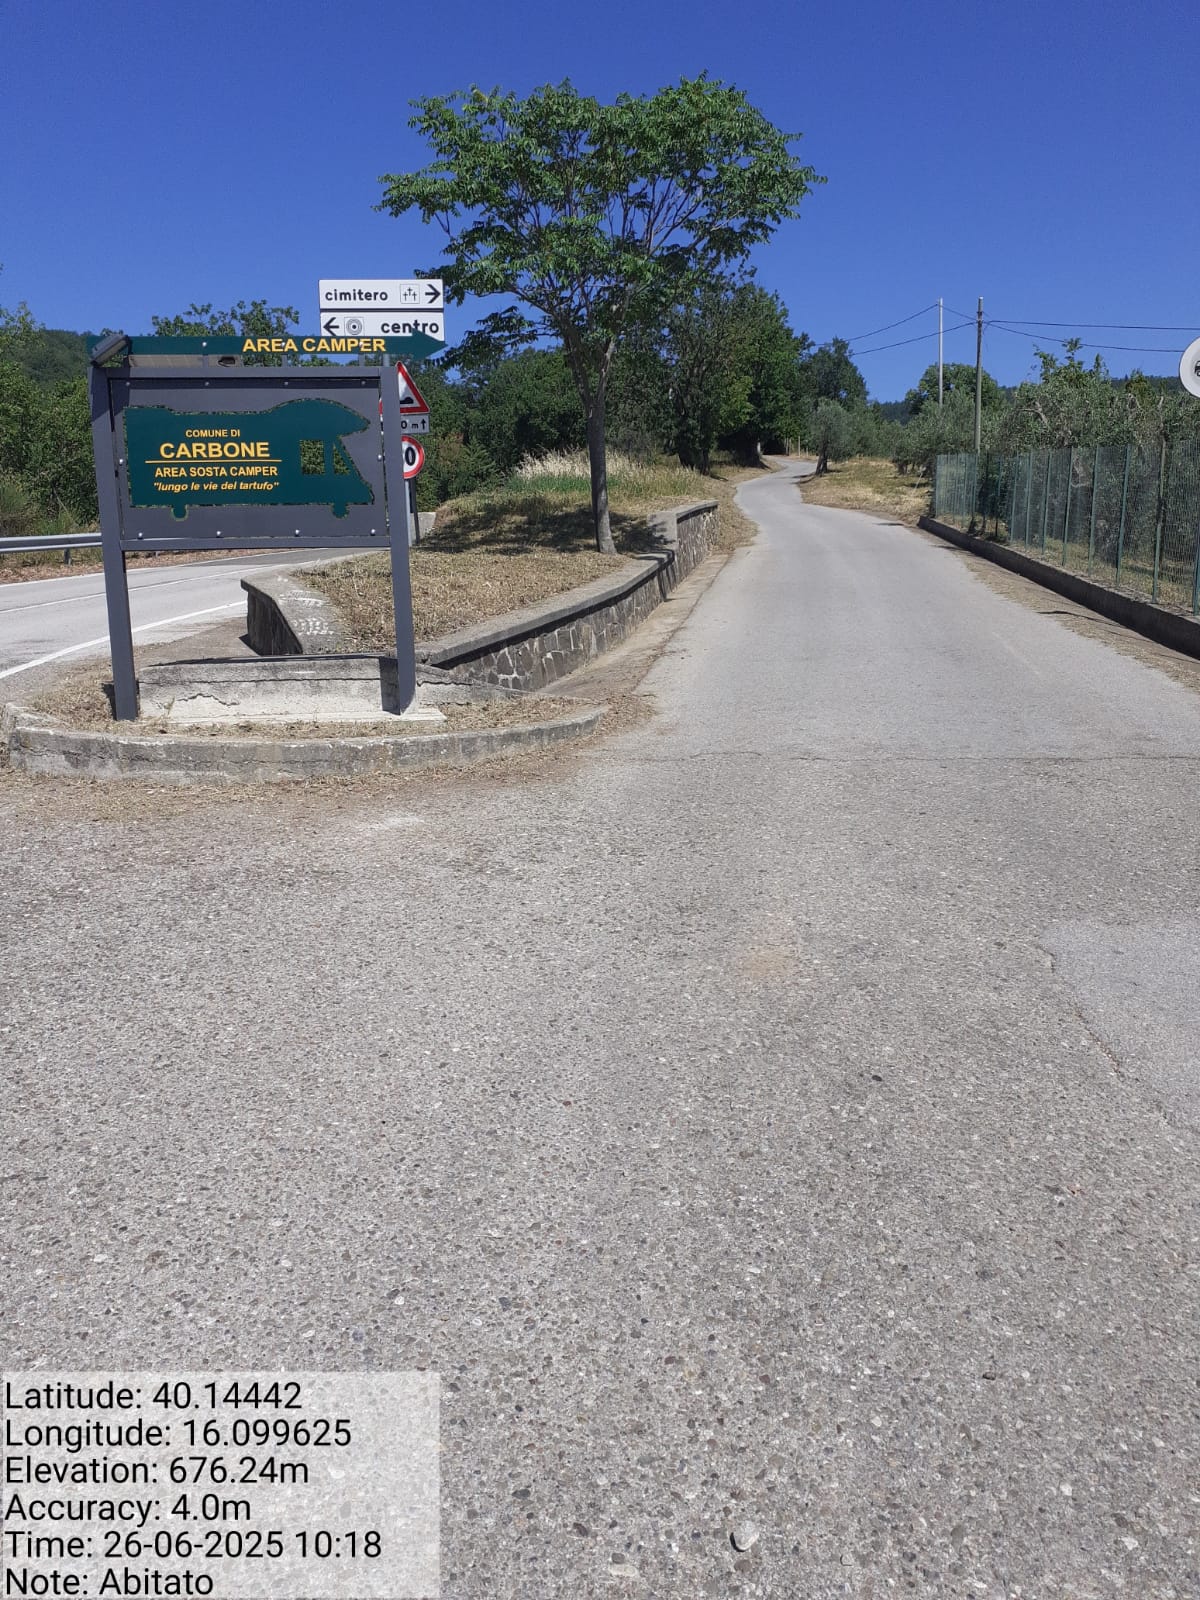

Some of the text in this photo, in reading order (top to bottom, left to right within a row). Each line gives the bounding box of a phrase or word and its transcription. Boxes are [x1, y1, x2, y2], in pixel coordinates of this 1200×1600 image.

[324, 288, 389, 301] cimitero
[380, 319, 440, 334] centro
[242, 337, 386, 352] AREA CAMPER
[185, 429, 241, 438] COMUNE DI
[159, 441, 271, 459] CARBONE
[154, 466, 278, 478] AREA SOSTA CAMPER
[153, 481, 280, 493] "lungo le vie del tartufo"
